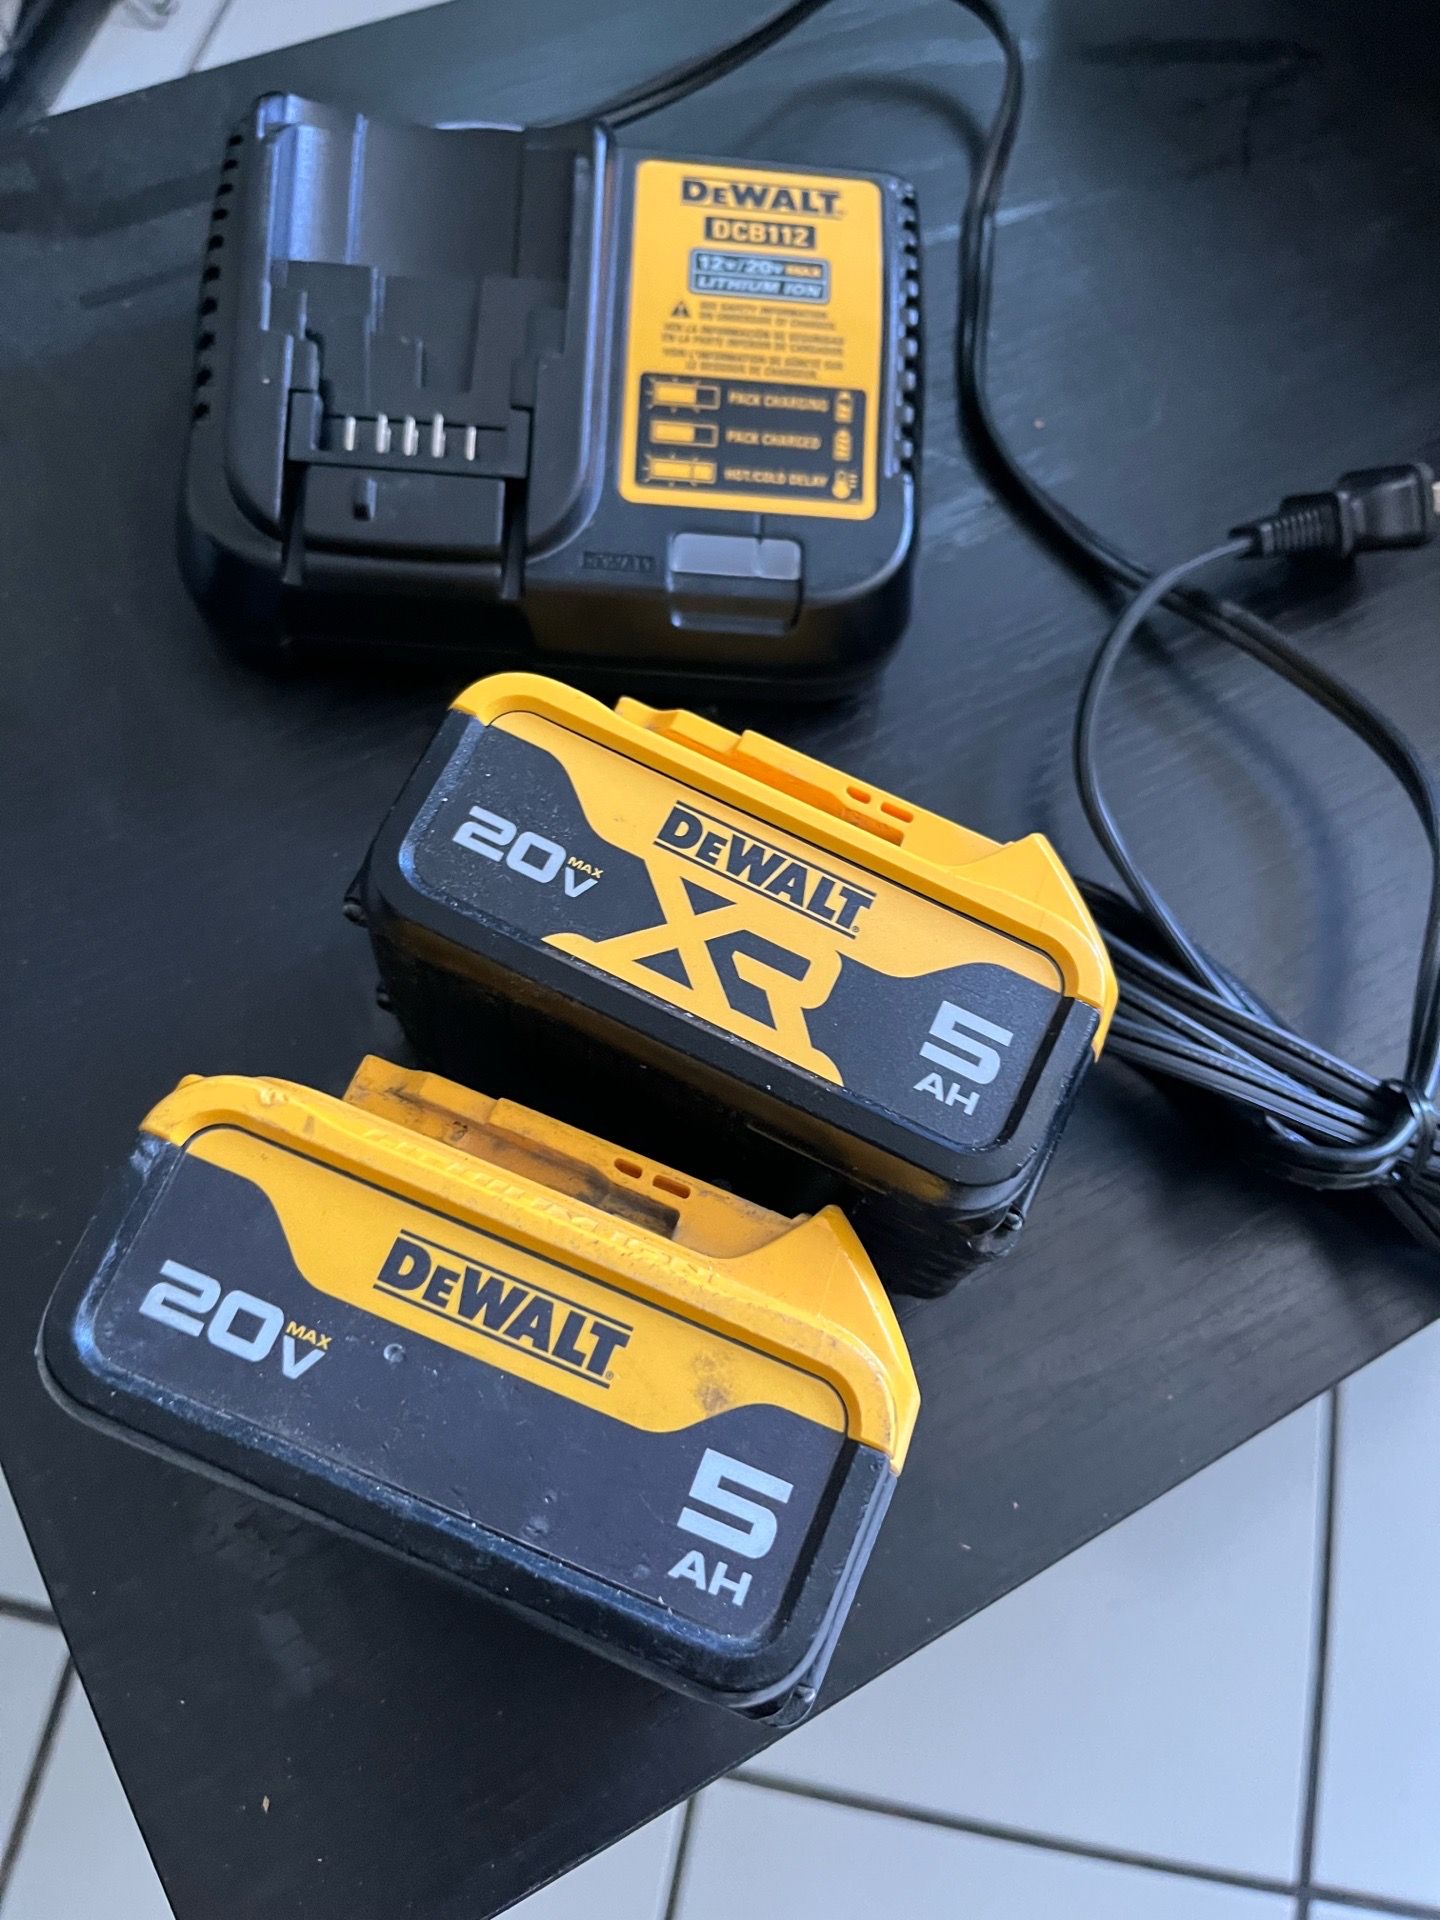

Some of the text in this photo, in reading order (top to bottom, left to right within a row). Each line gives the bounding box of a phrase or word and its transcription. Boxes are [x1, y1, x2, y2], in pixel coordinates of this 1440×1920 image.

[712, 221, 810, 248] DCB112
[698, 276, 822, 298] LITHIUM ION
[728, 391, 761, 406] PACK
[725, 430, 759, 445] PACK
[568, 855, 605, 882] MAX
[920, 1001, 1014, 1085] 5
[913, 1072, 980, 1116] AH
[285, 1320, 332, 1351] MAX
[676, 1447, 794, 1559] 5
[668, 1550, 753, 1606] AH
